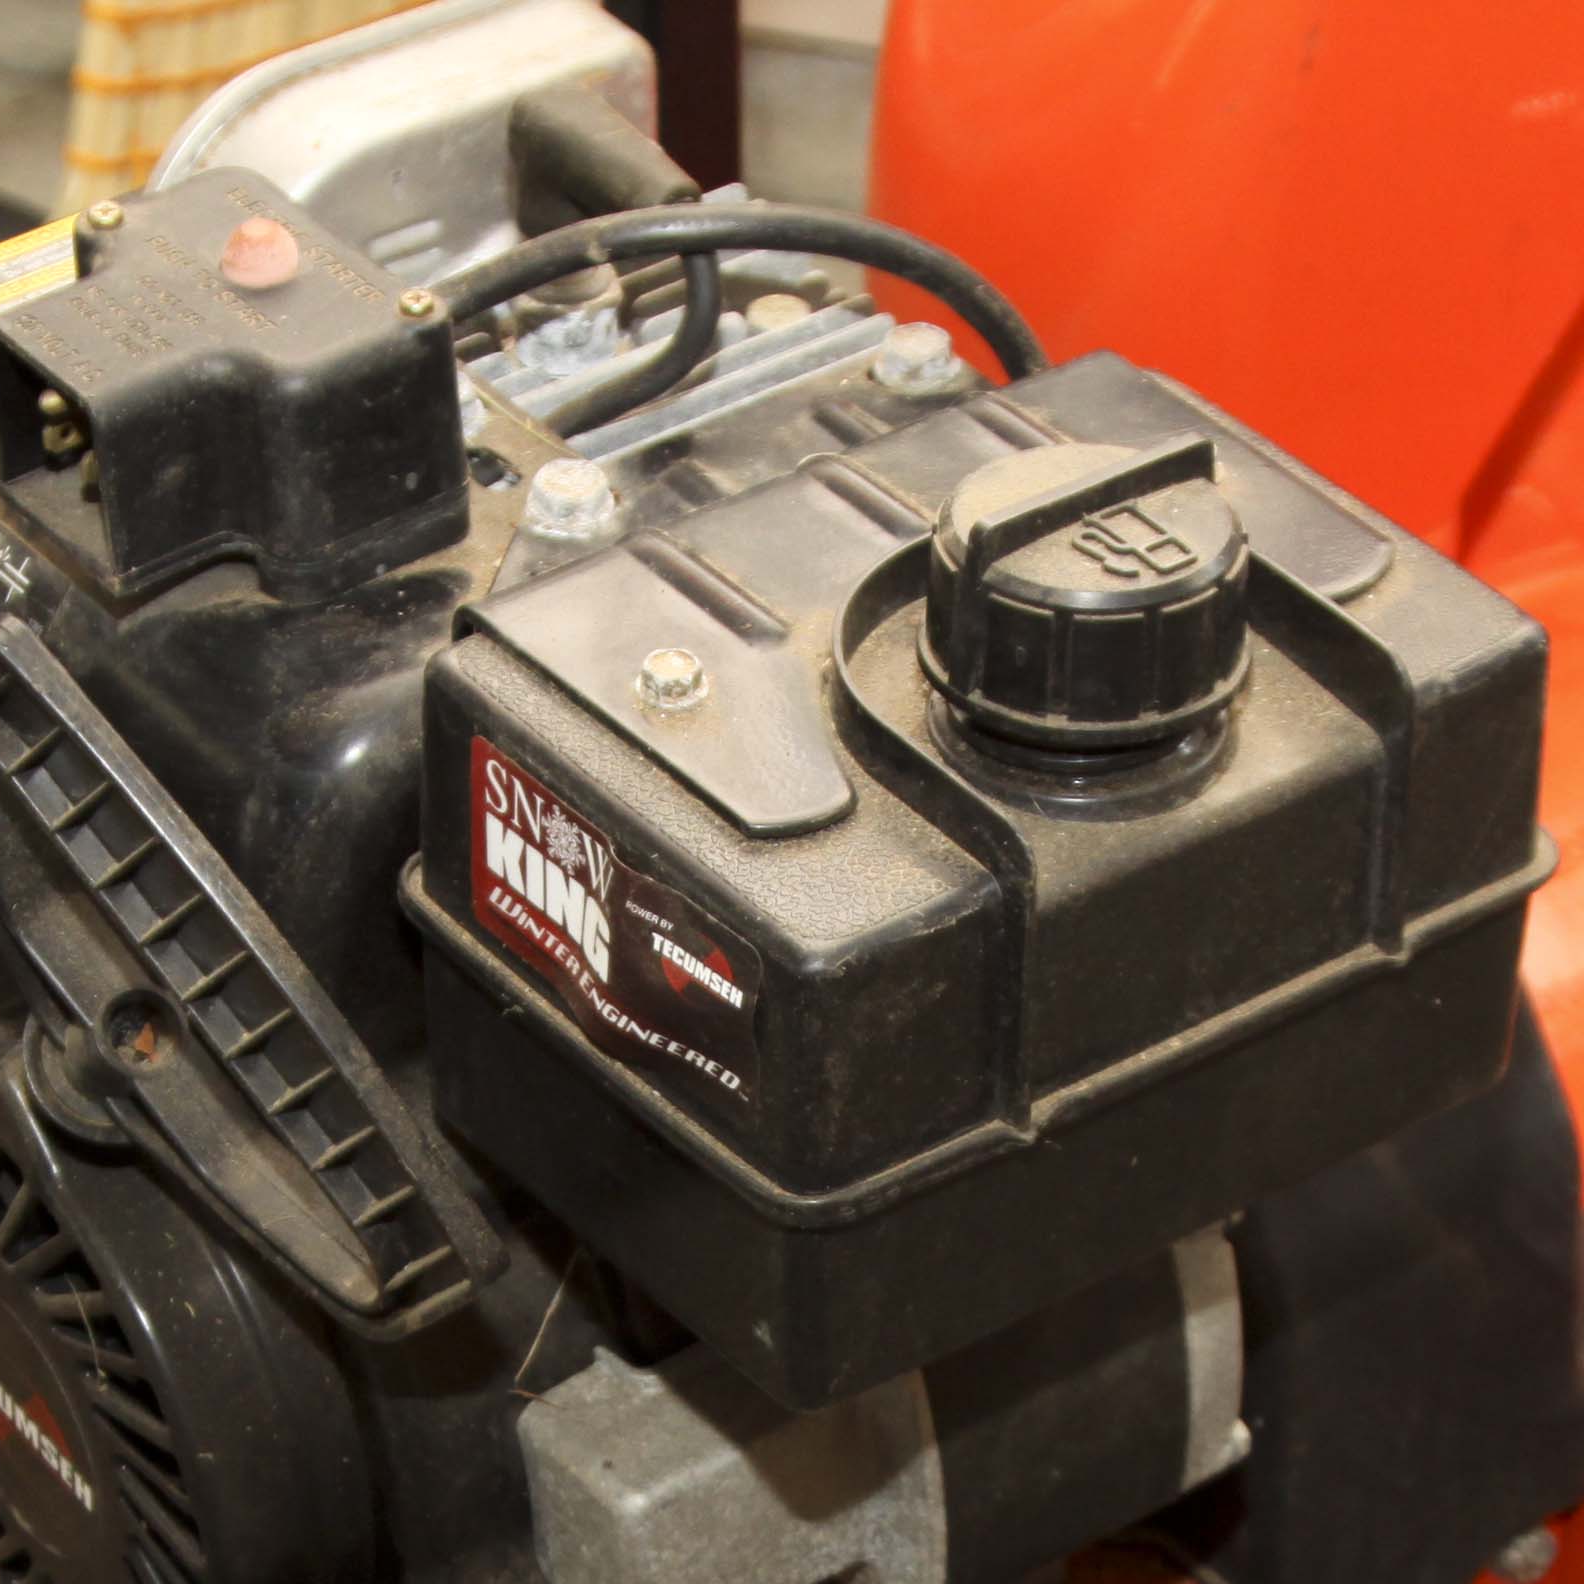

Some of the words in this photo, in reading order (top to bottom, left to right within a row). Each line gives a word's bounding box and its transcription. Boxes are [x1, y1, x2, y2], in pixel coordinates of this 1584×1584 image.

[301, 247, 385, 304] STARTER
[485, 811, 611, 985] KING
[625, 900, 660, 925] POWER
[659, 918, 675, 931] BY
[488, 886, 582, 977] WINTER
[578, 973, 742, 1091] ENGINEERED
[651, 931, 744, 1009] TECUMSEH
